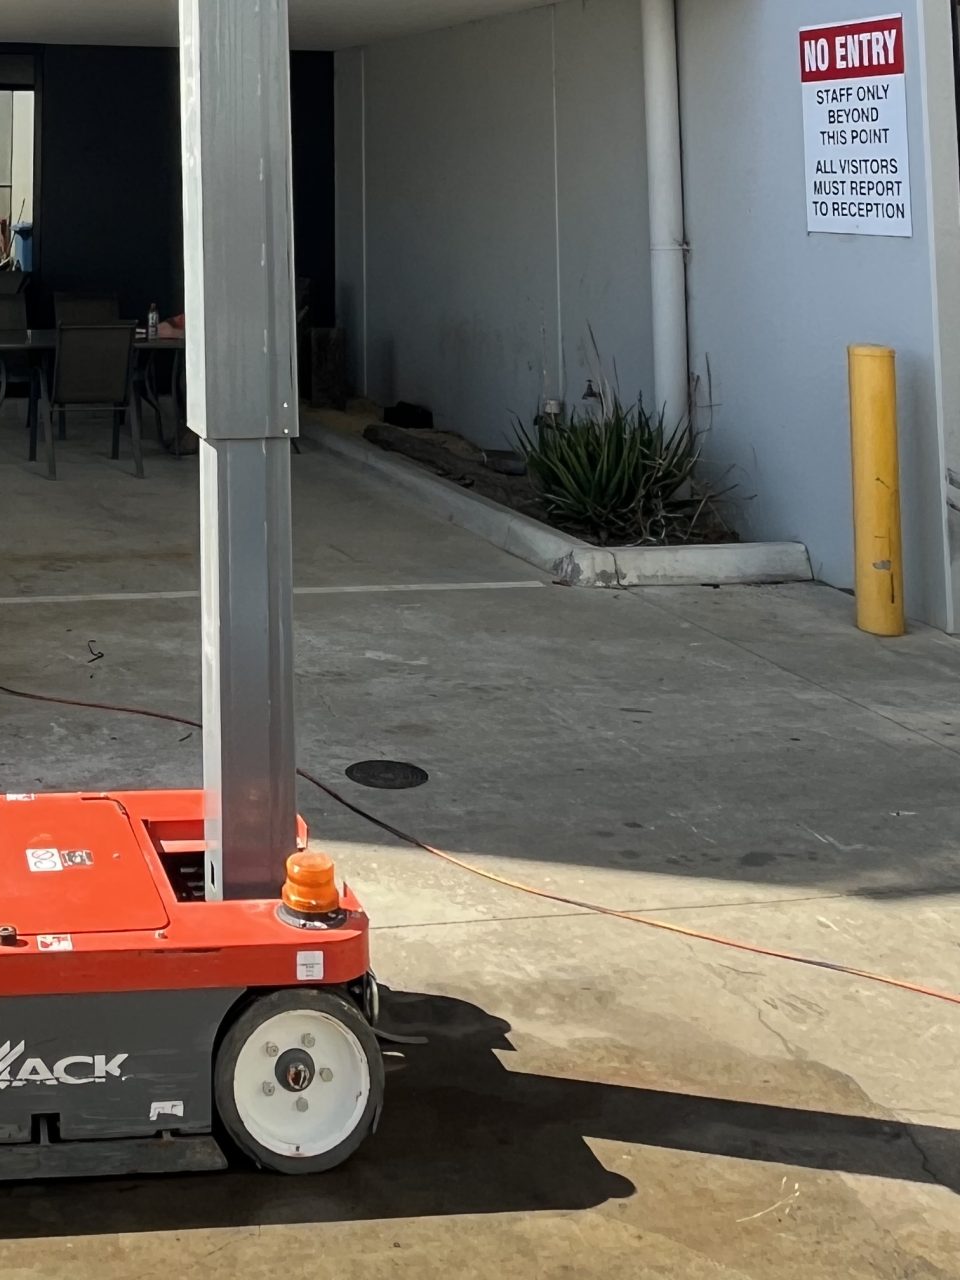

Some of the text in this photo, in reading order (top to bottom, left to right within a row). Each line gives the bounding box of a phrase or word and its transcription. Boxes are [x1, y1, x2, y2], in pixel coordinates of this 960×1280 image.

[803, 28, 897, 73] NO ENTRY
[816, 84, 890, 105] STAFF ONLY
[828, 107, 879, 124] BEYOND
[820, 128, 890, 146] THIS POINT
[815, 158, 898, 175] ALL VISITORS
[813, 180, 902, 197] MUST REPORT
[812, 200, 905, 219] TO RECEPTION
